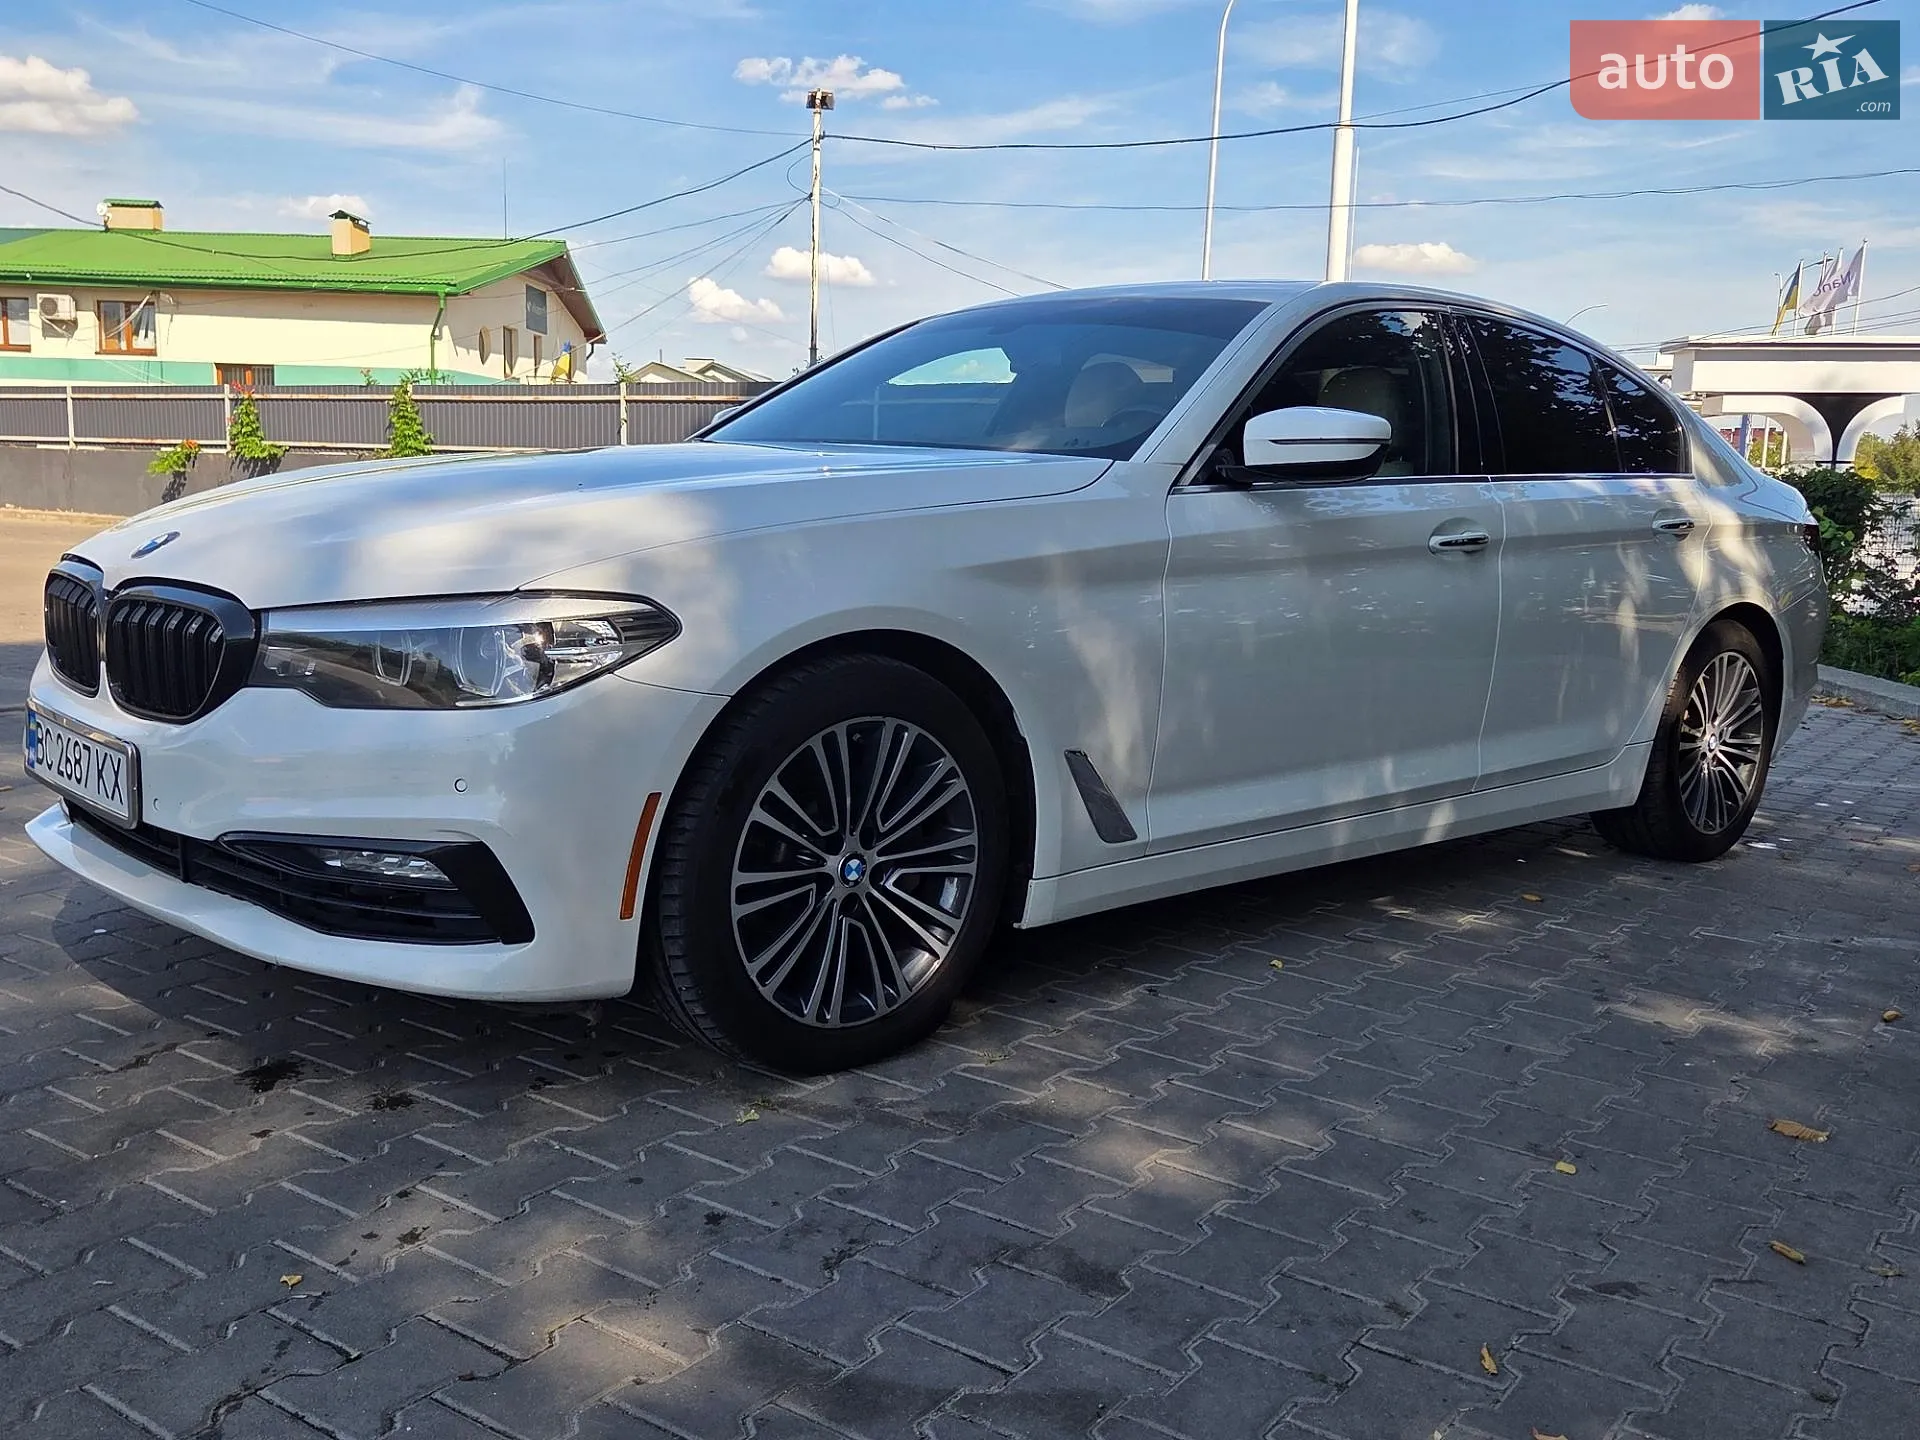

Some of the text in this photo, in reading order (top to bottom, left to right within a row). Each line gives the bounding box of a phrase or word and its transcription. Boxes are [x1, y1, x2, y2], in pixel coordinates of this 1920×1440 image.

[36, 721, 123, 806] BC 2687 KX
